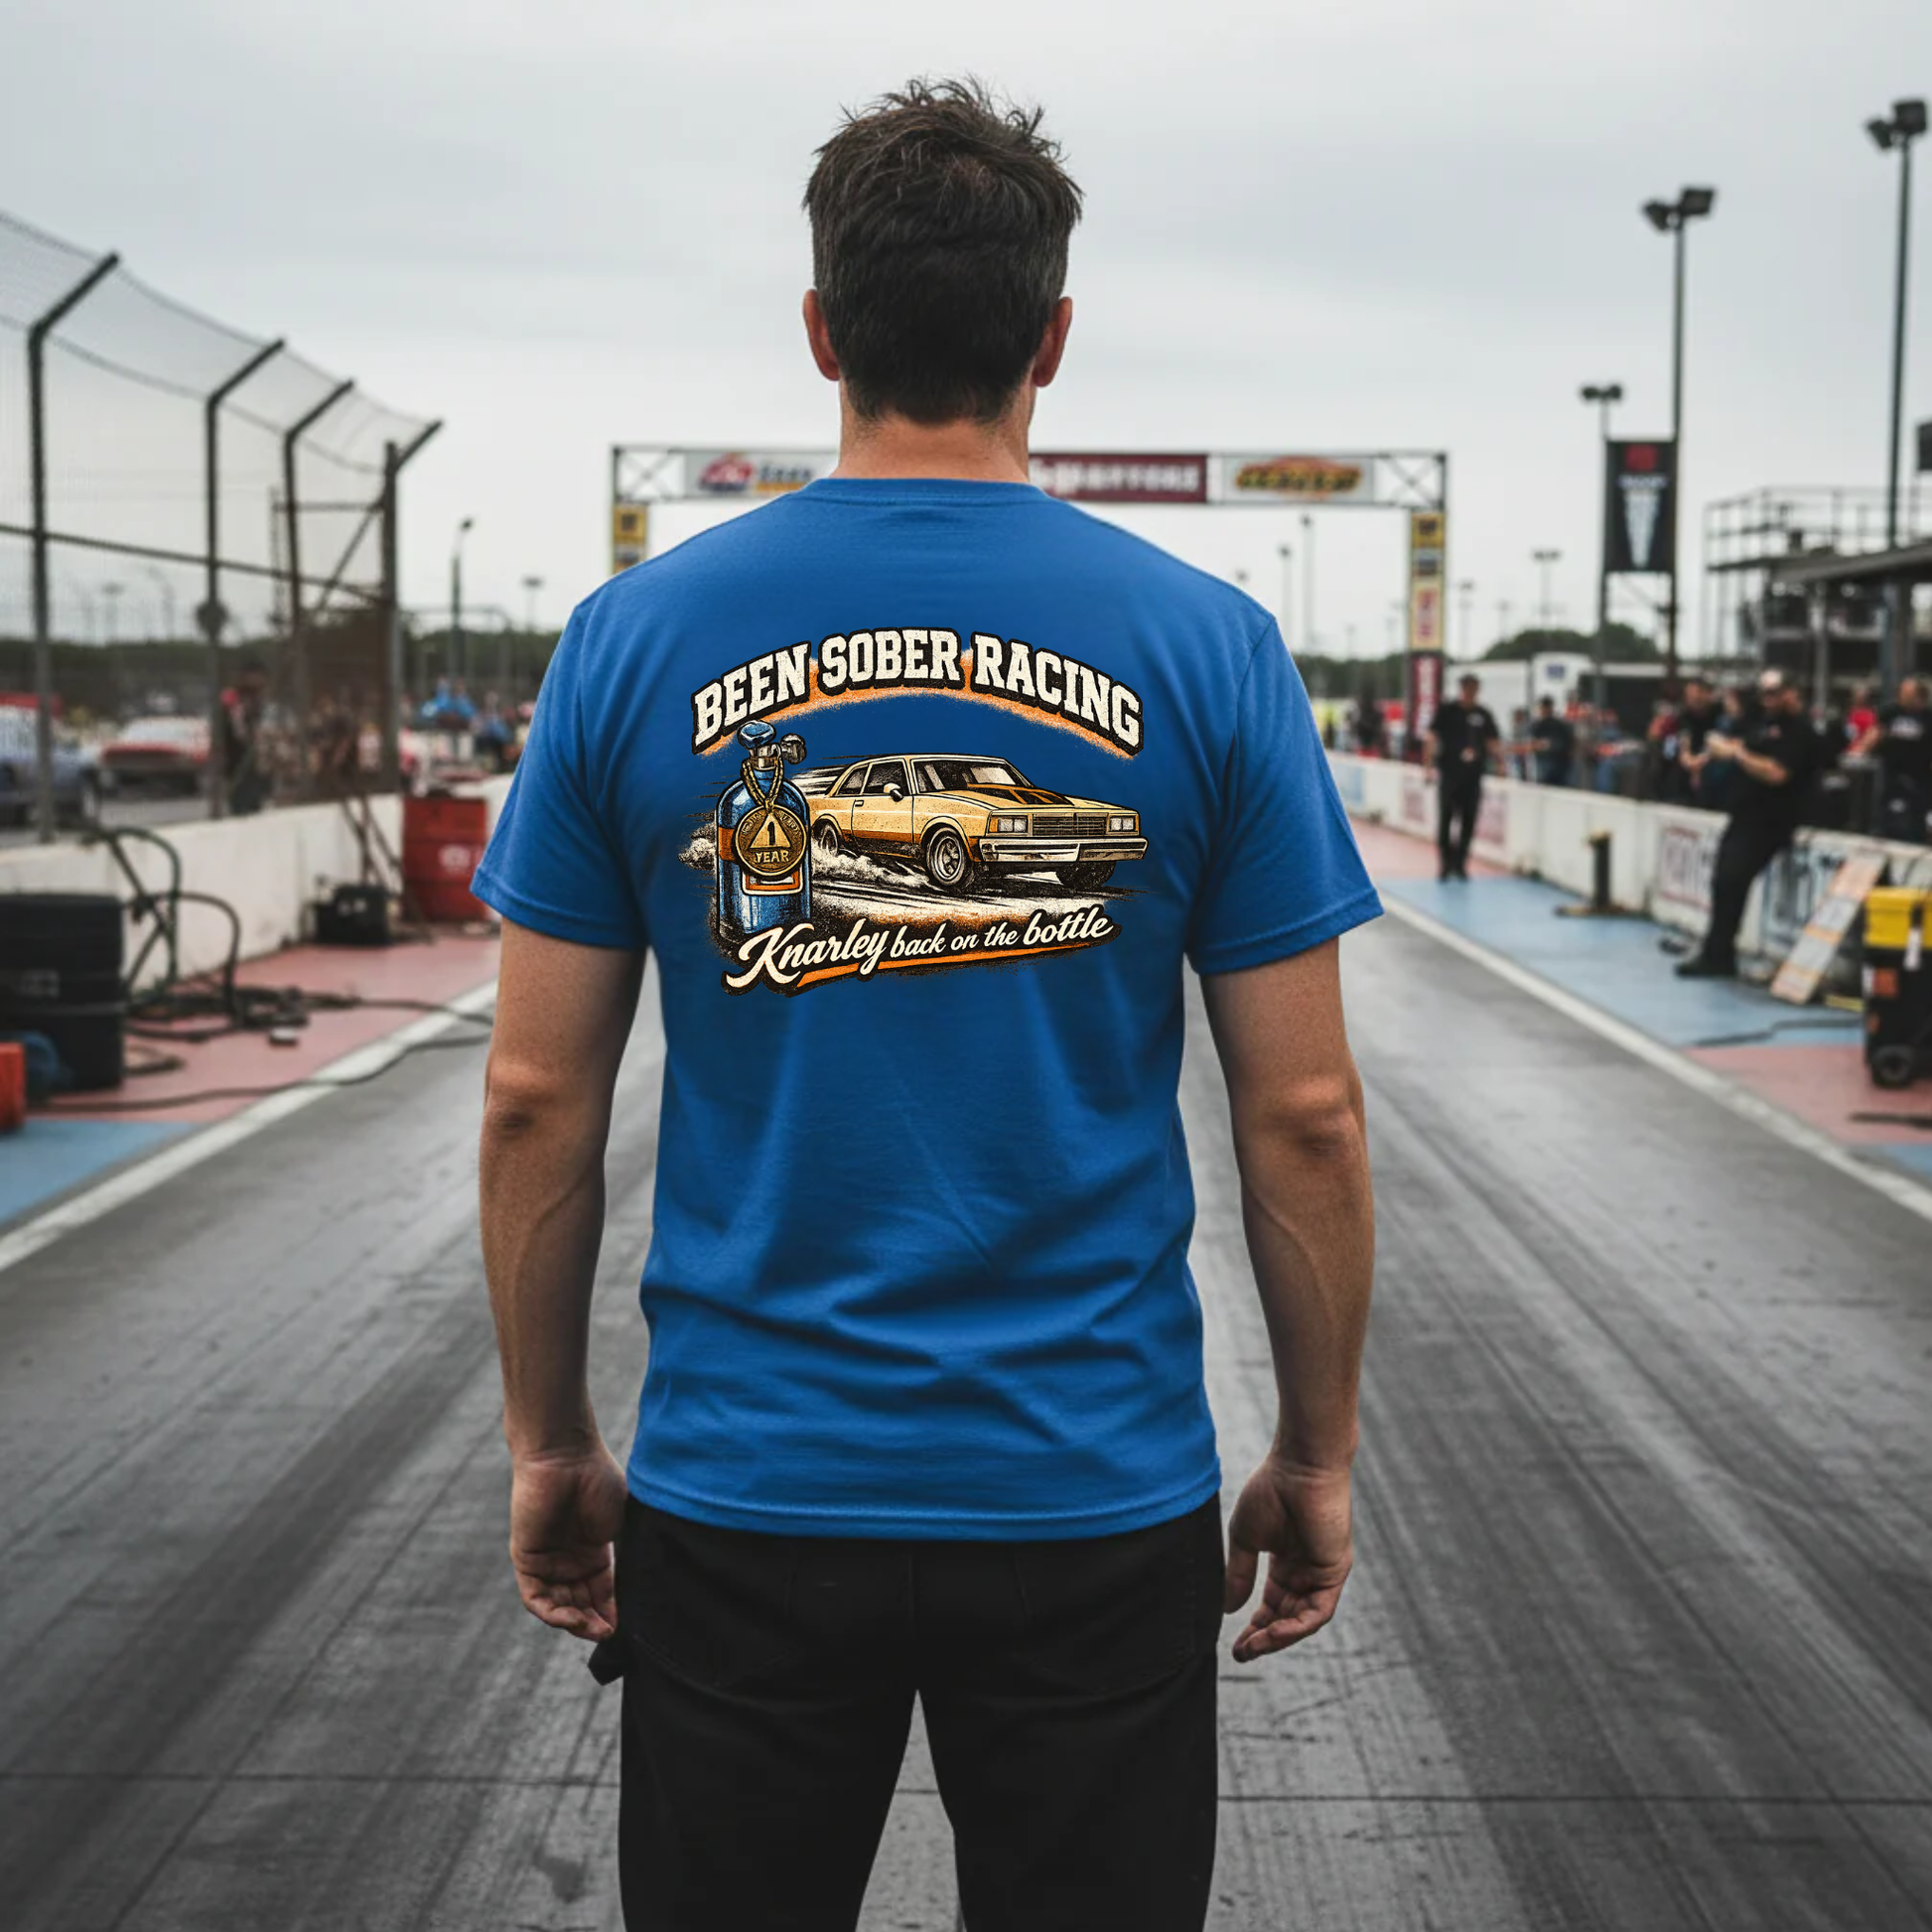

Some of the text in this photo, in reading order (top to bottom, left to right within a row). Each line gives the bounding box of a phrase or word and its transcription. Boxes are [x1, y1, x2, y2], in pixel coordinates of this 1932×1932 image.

[694, 629, 1142, 748] BEEN SOBER RACING
[755, 850, 789, 864] YEAR
[767, 821, 776, 846] 1
[726, 906, 1113, 989] Knarley back on the bottle
